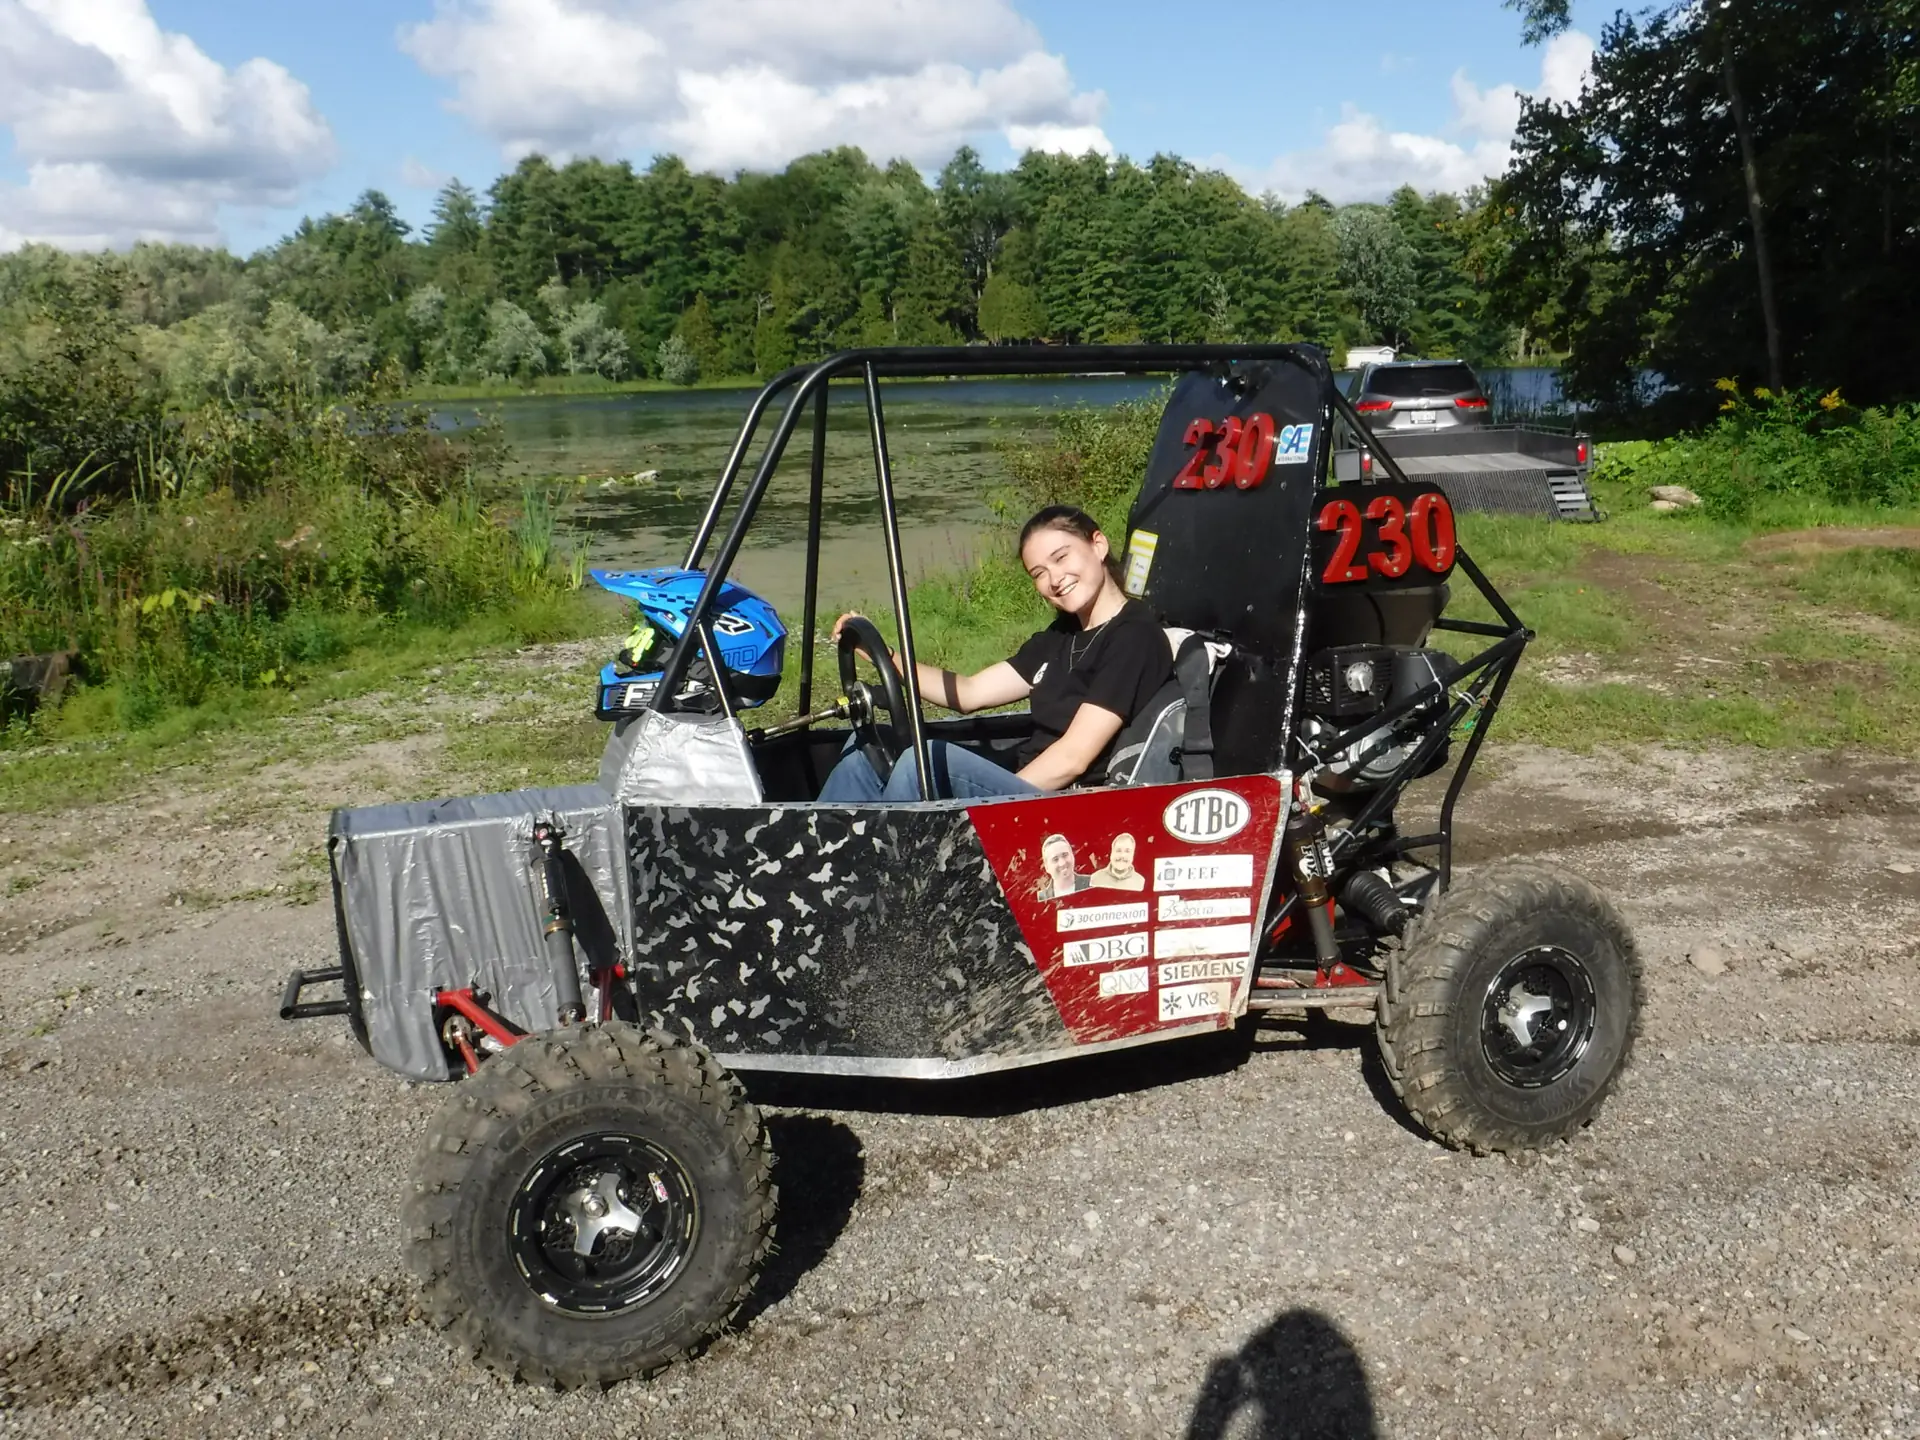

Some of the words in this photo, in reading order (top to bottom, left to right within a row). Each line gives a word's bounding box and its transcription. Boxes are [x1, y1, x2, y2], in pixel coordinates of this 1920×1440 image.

[1173, 413, 1274, 490] 230
[1279, 425, 1312, 454] SAE
[1318, 493, 1456, 583] 230
[1173, 796, 1238, 835] ETBO
[1300, 845, 1320, 881] FOX
[1088, 936, 1145, 962] DBG
[1101, 970, 1146, 994] QNX
[1164, 961, 1245, 981] SIEMENS
[1187, 991, 1219, 1008] VR3
